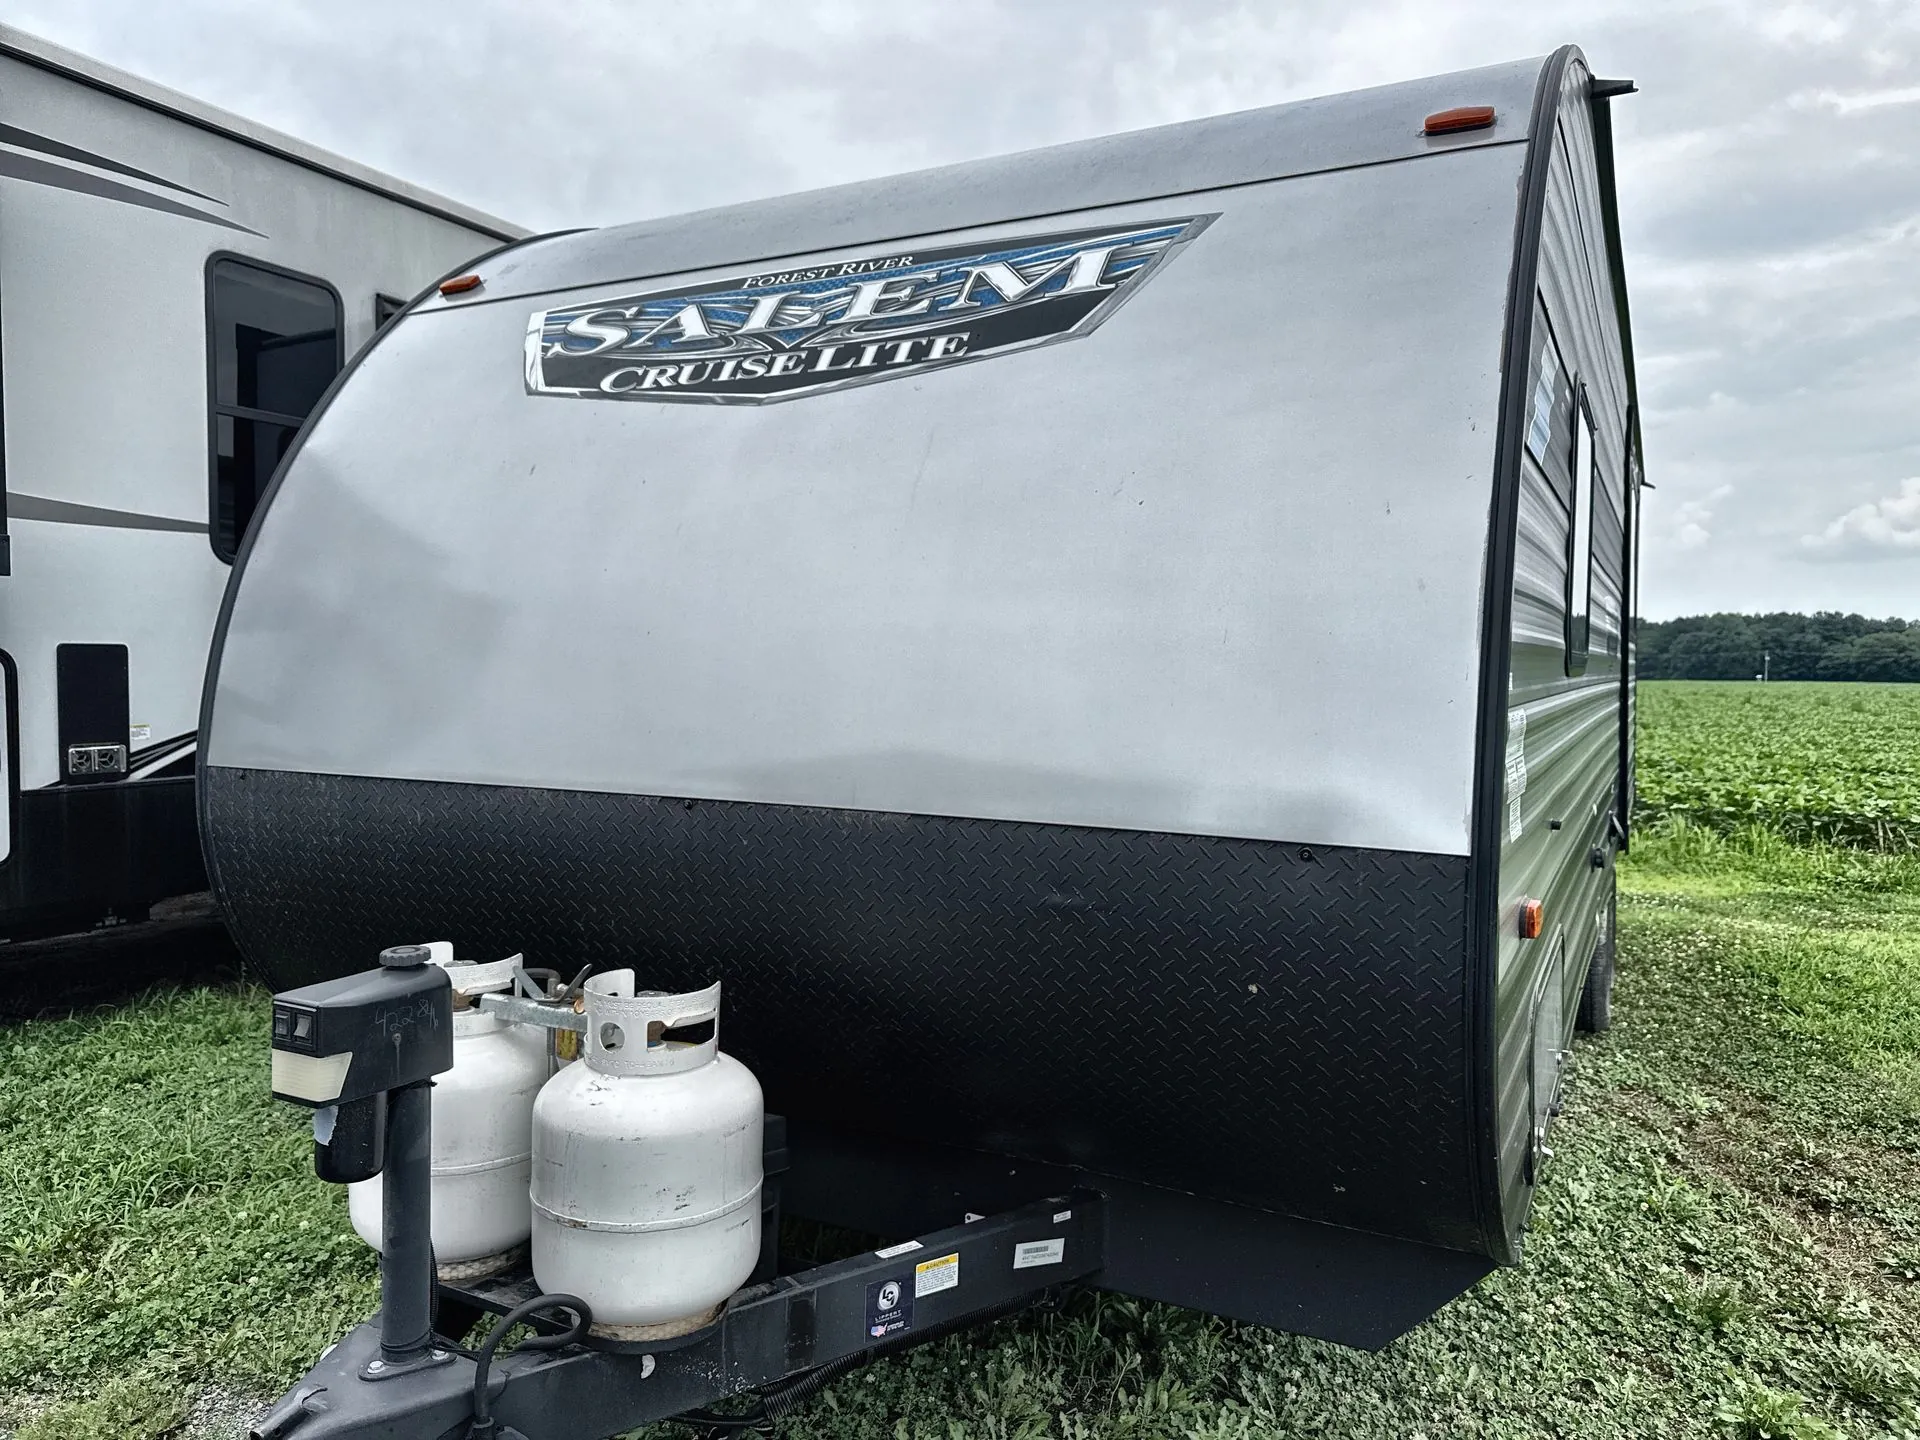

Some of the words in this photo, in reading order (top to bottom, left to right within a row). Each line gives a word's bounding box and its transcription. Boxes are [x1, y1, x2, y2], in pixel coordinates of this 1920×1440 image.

[545, 241, 1136, 358] SALEM
[742, 267, 835, 290] FOREST
[836, 255, 915, 277] RIVER
[599, 352, 808, 393] CRUISE
[806, 331, 972, 374] LITE
